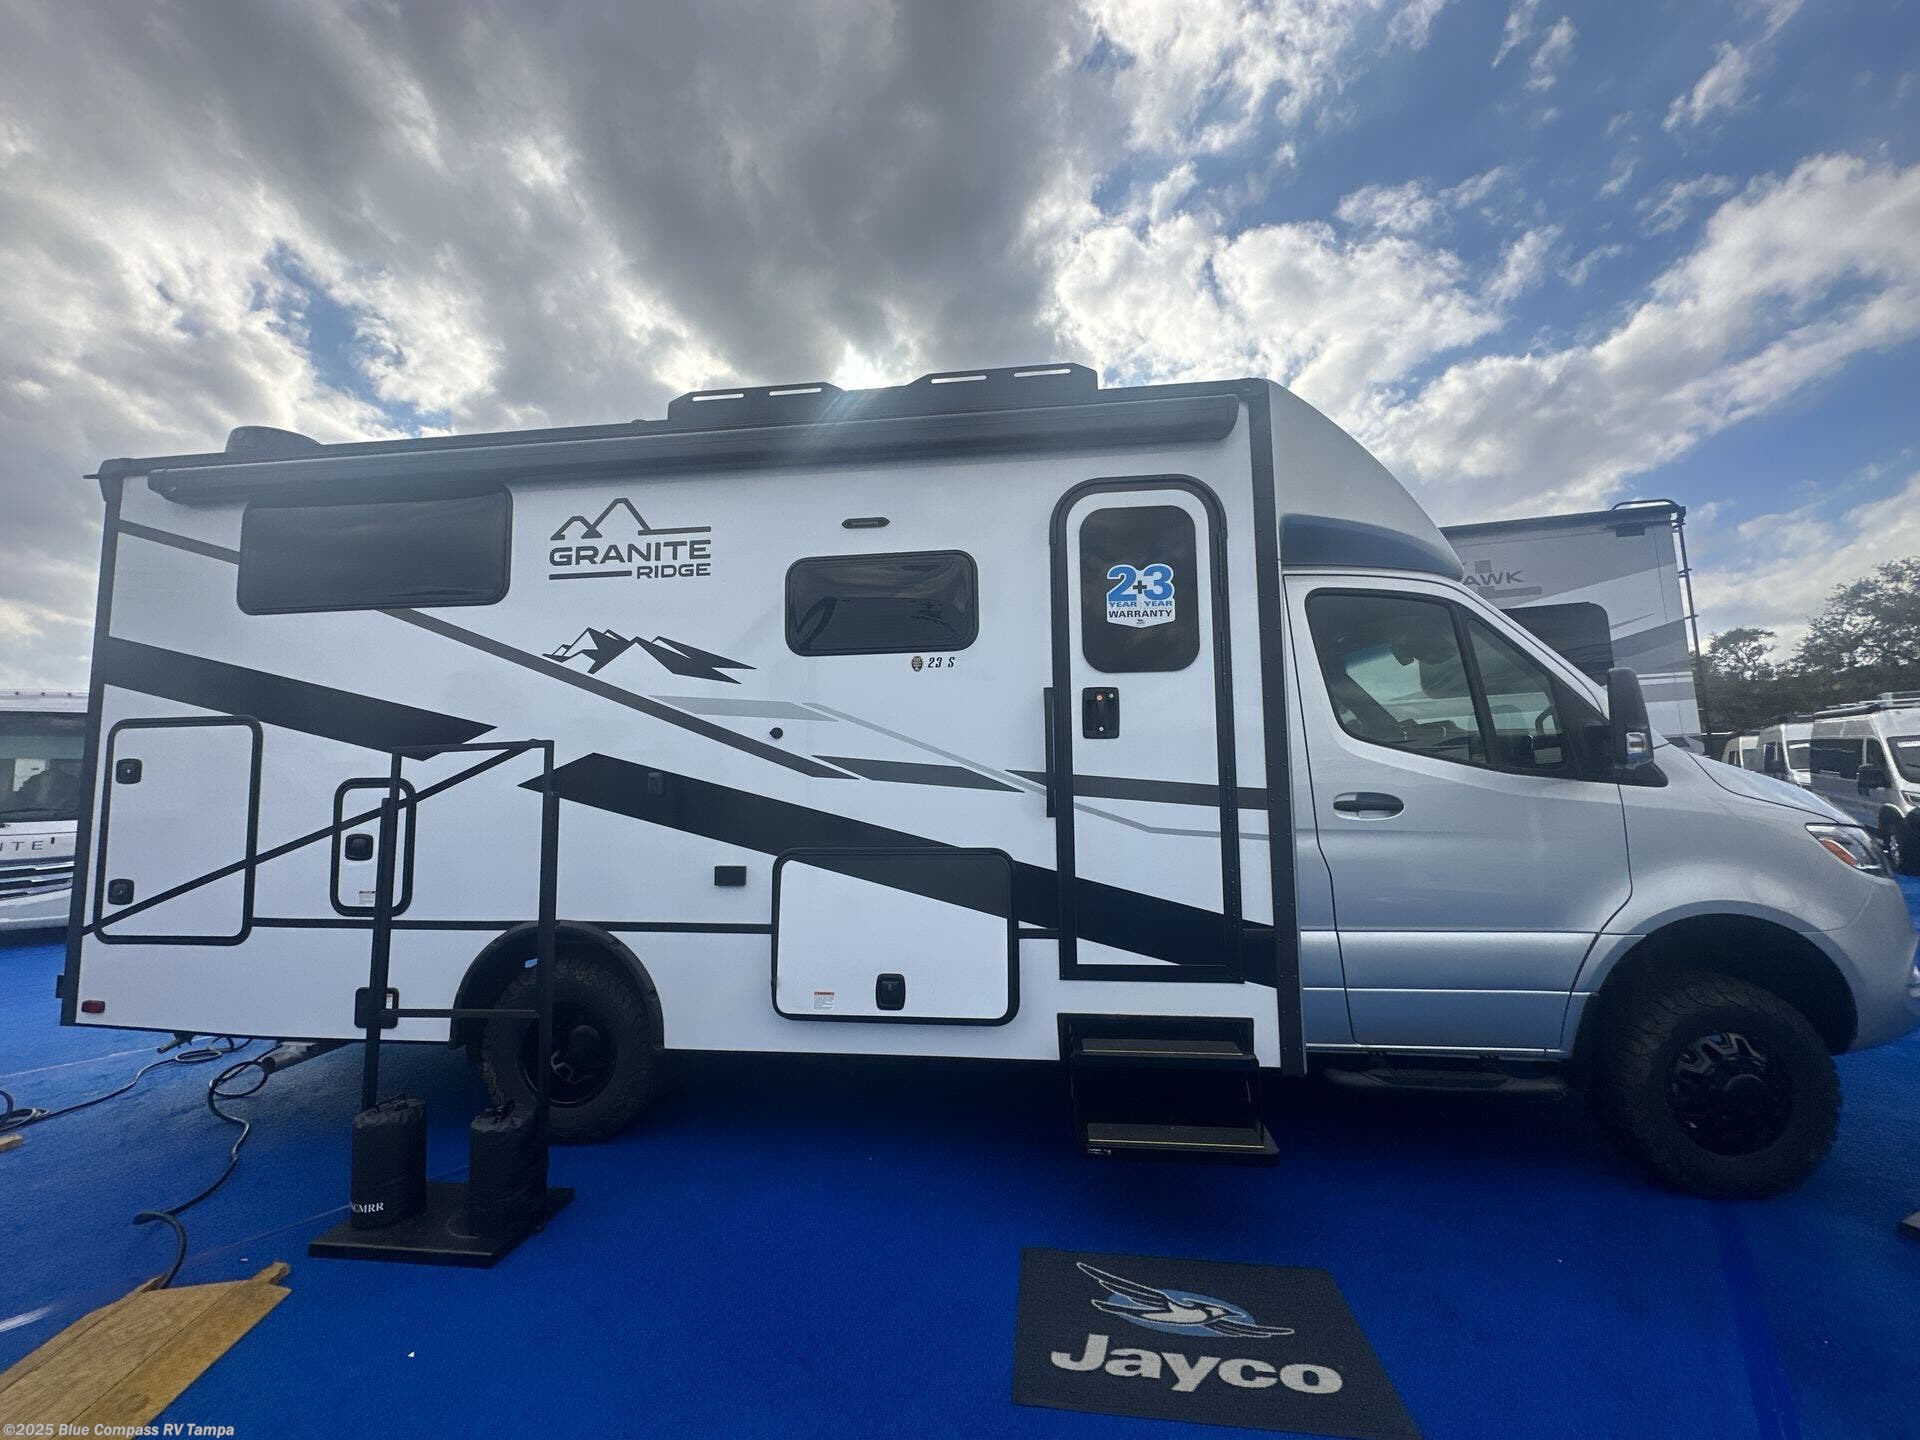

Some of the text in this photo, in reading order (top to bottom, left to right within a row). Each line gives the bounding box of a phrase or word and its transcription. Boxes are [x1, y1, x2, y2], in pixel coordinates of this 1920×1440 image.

[549, 540, 711, 566] GRANITE
[637, 563, 711, 579] RIDGE
[1109, 610, 1172, 618] WARRANTY
[928, 656, 955, 668] 23 S
[1051, 1334, 1343, 1394] Jayco
